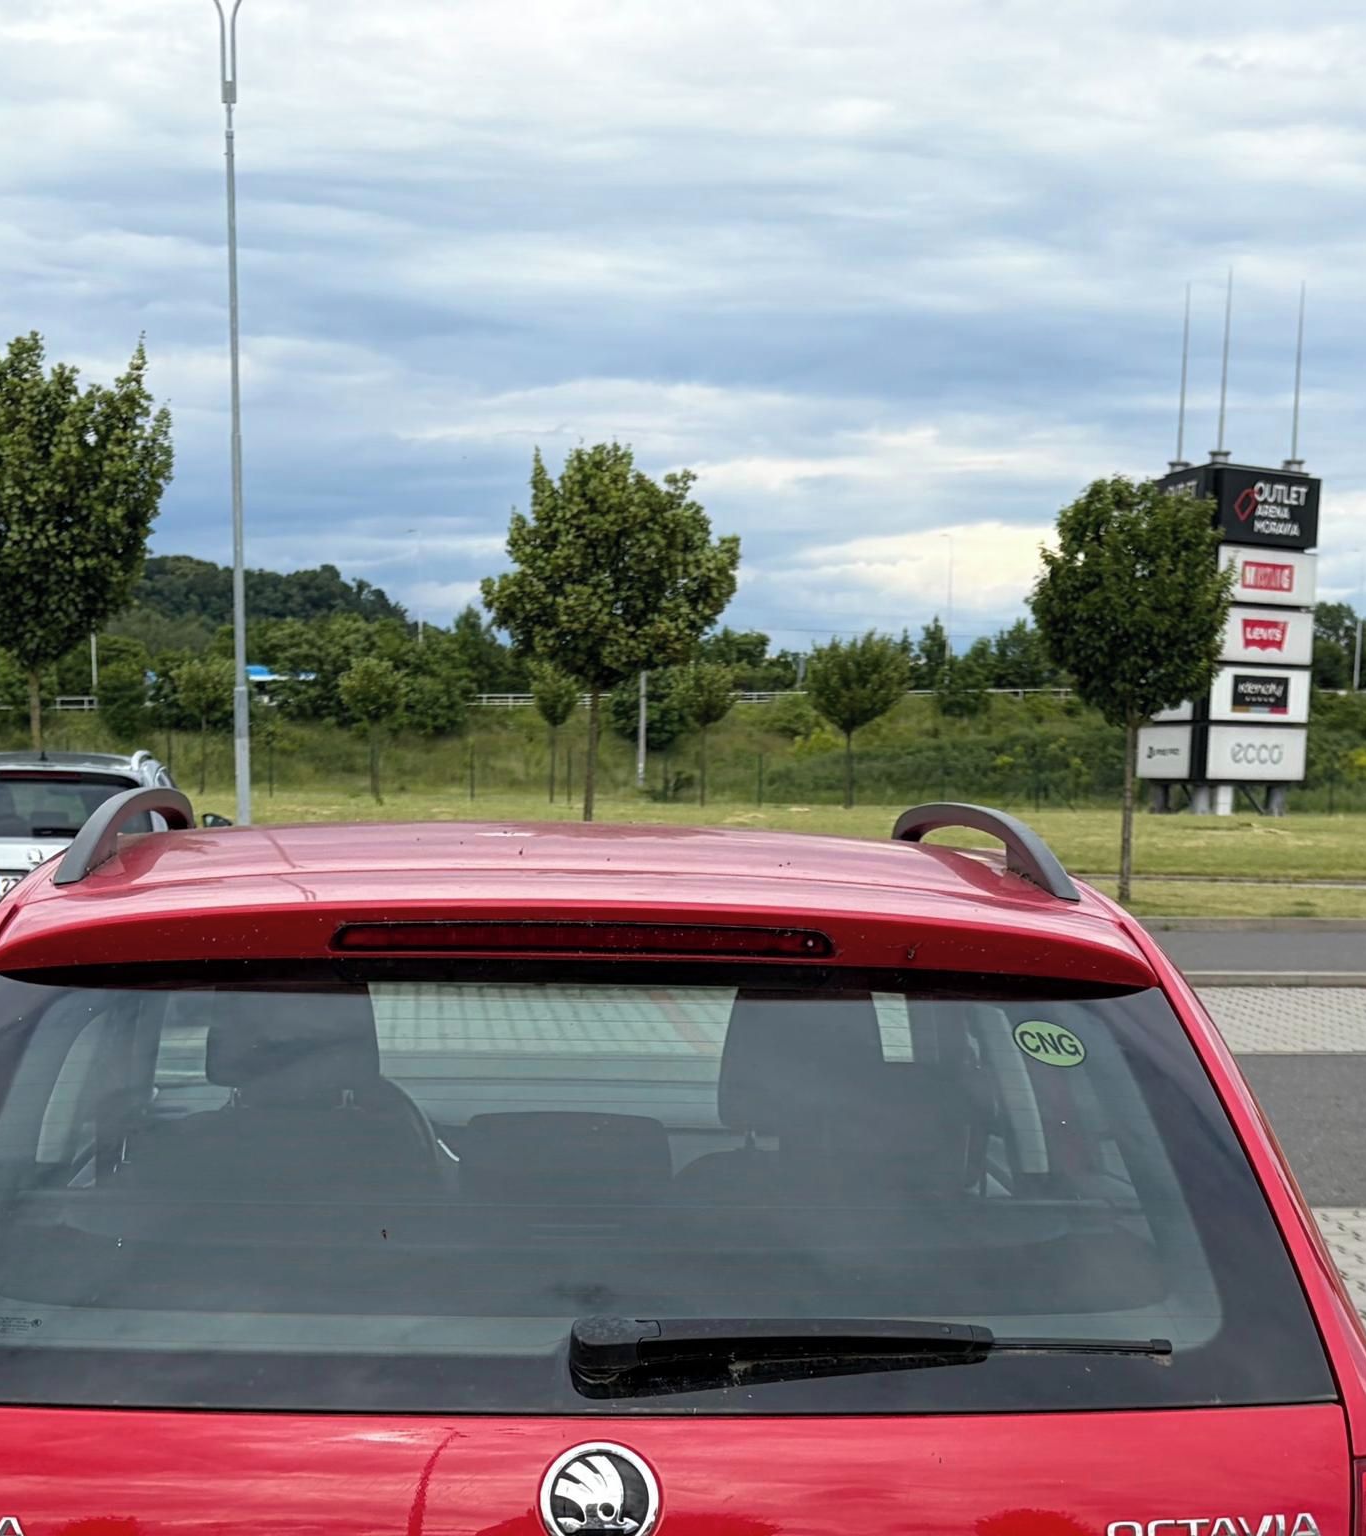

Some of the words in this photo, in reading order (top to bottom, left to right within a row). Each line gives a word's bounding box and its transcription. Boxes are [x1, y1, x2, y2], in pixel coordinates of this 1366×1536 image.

[1254, 481, 1308, 507] OUTLET
[1255, 504, 1290, 520] ARENA
[1253, 520, 1301, 537] MORAVA
[1231, 743, 1283, 765] ecco
[1019, 1030, 1082, 1057] CNG
